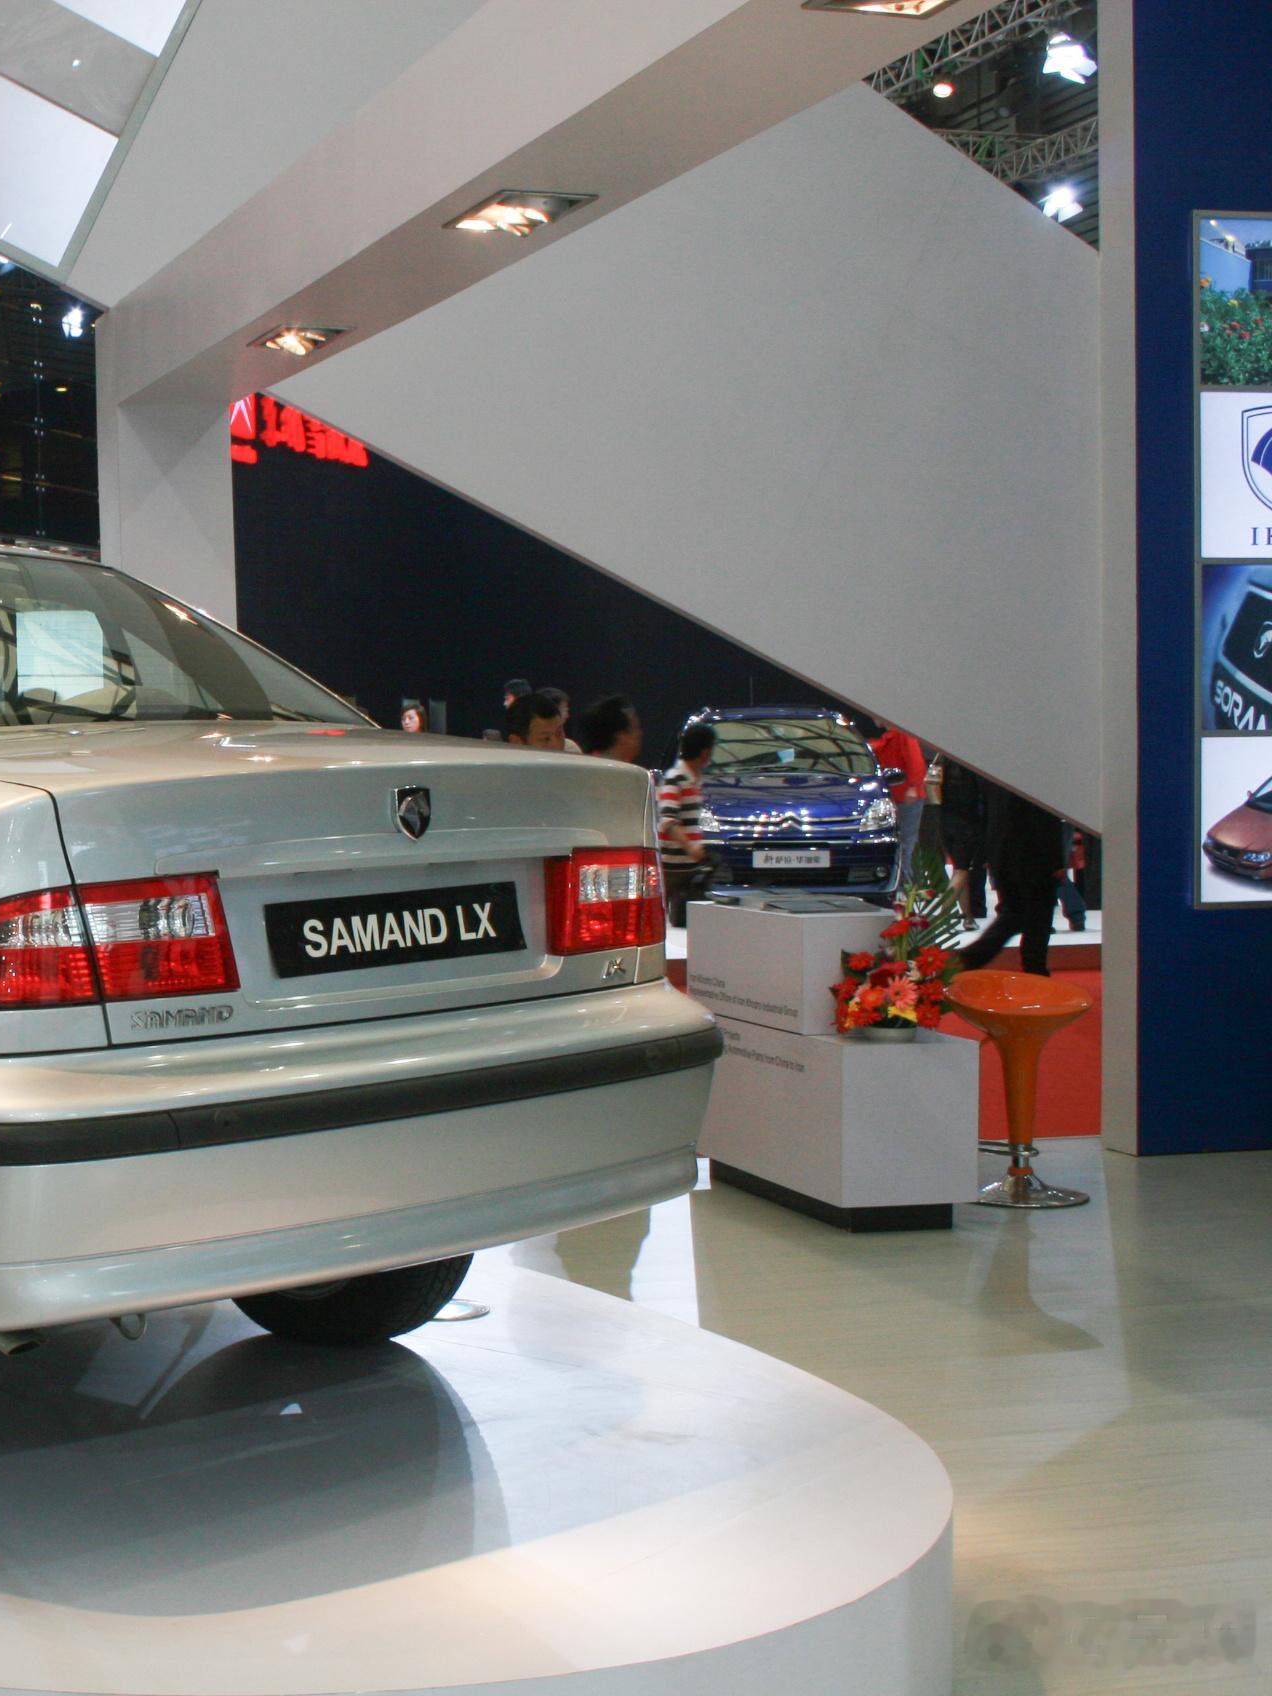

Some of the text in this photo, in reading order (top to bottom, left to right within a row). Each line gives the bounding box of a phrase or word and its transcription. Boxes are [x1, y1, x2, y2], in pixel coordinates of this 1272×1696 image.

[303, 902, 497, 958] SAMAND LX
[130, 1005, 234, 1030] SAMAND
